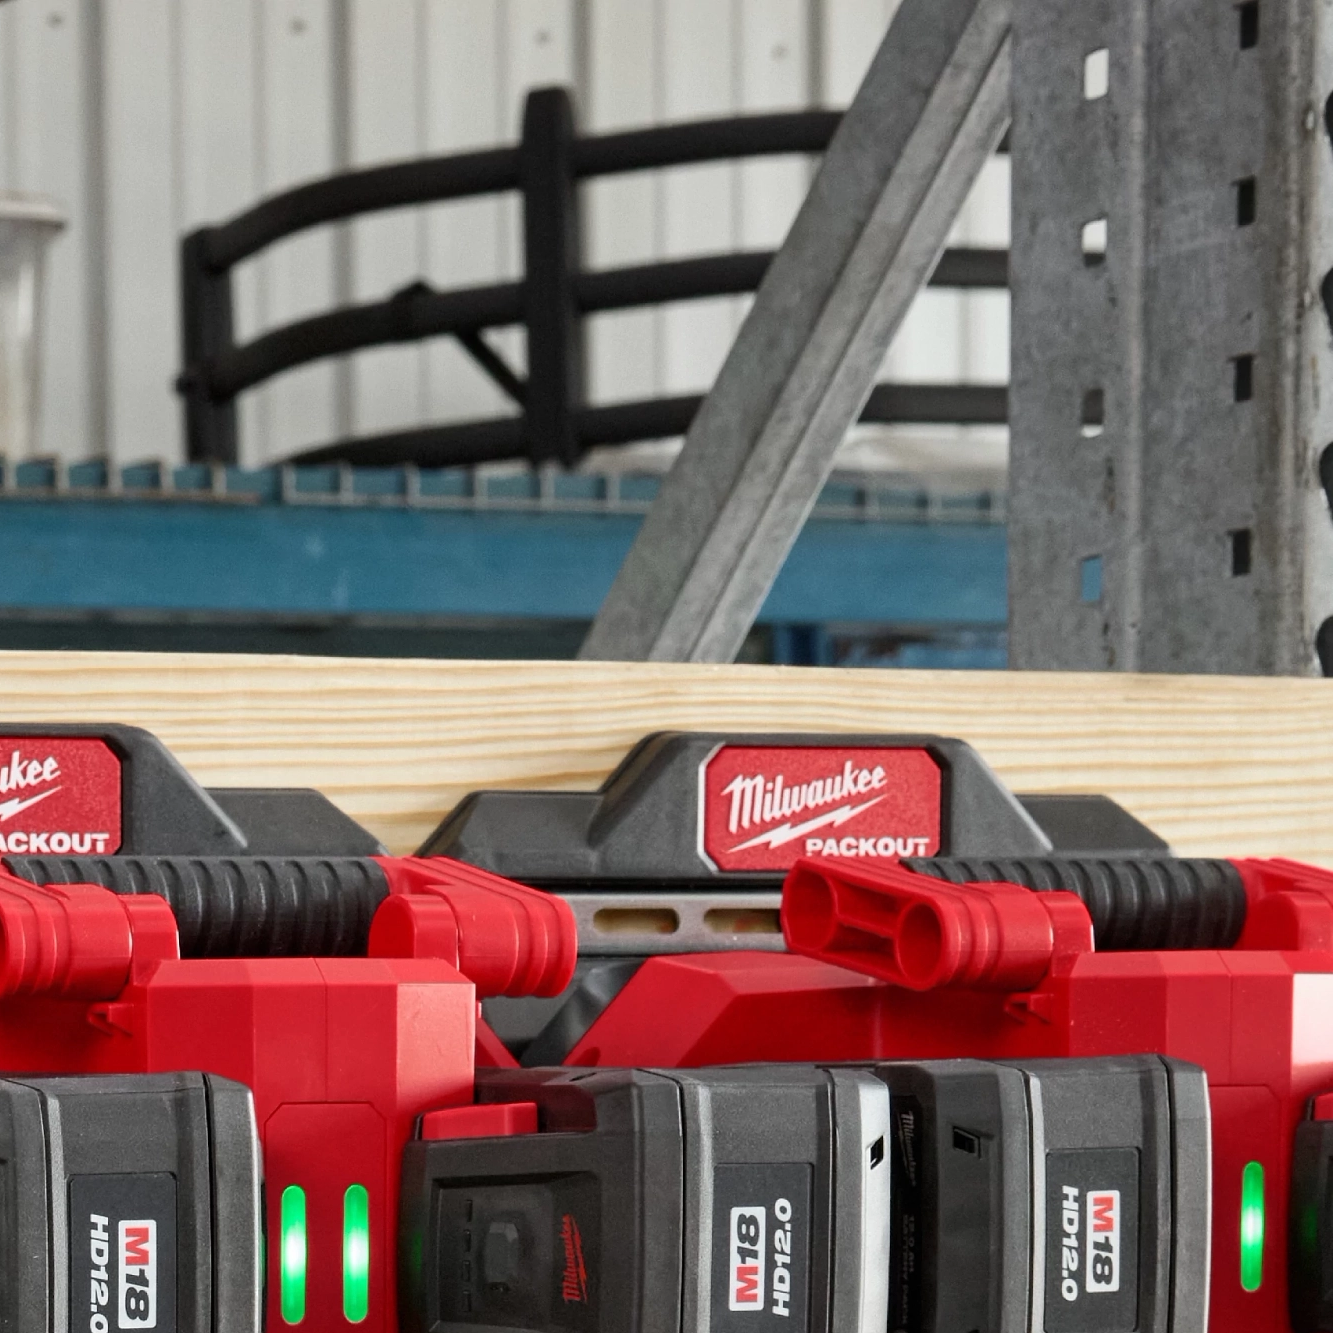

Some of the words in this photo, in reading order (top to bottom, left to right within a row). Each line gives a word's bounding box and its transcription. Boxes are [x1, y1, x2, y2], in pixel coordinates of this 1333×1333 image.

[721, 760, 888, 833] Milwaukee
[805, 838, 930, 857] PACKOUT
[124, 1227, 150, 1321] M18
[735, 1213, 760, 1303] M18
[772, 1198, 792, 1317] HD12.0
[1061, 1185, 1079, 1301] HD12.0
[1092, 1196, 1114, 1286] M18
